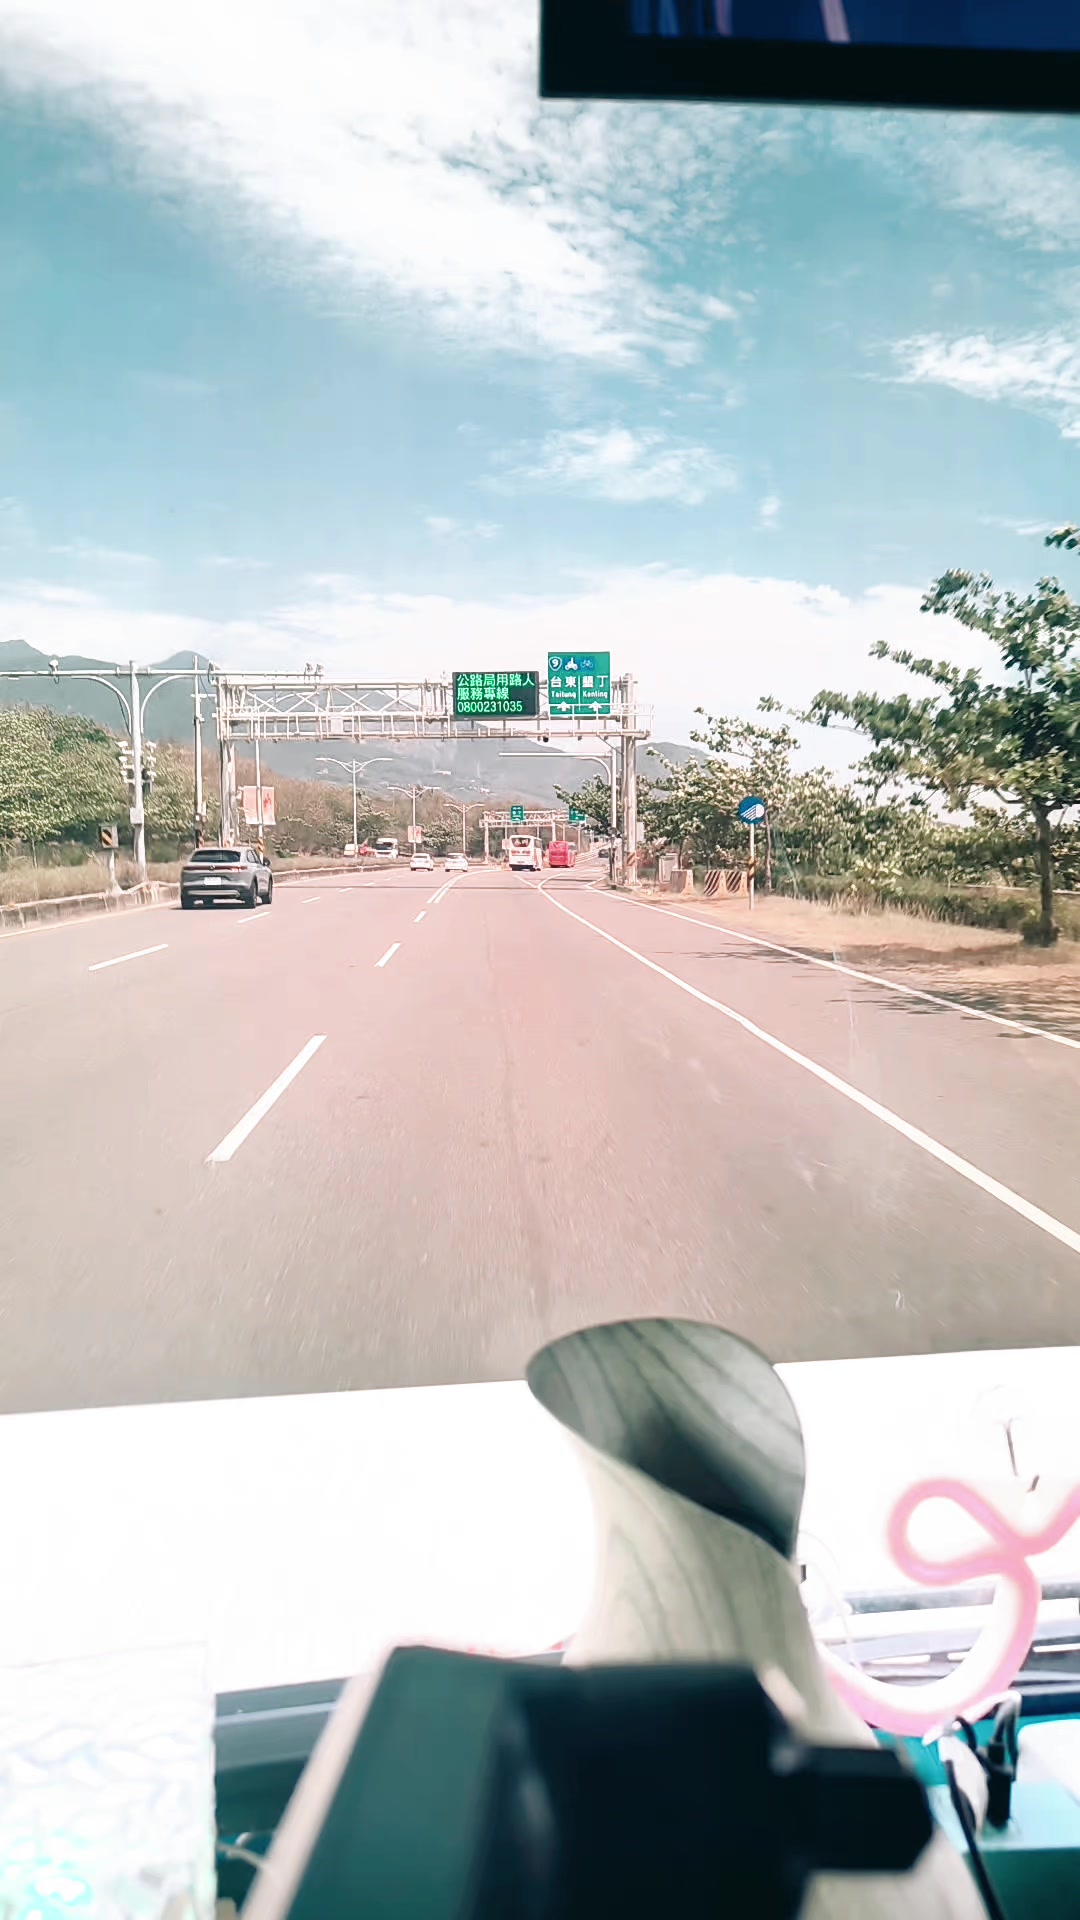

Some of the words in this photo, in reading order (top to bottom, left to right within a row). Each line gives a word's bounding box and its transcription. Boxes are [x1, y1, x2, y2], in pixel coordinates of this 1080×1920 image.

[552, 658, 559, 668] 9
[457, 673, 535, 687] 公路局用路人
[551, 676, 576, 688] 台東
[582, 676, 608, 688] 墾丁
[457, 688, 509, 700] 服務專線
[552, 691, 576, 700] Taitung
[583, 690, 608, 699] Kenting
[457, 701, 522, 712] 0800231035
